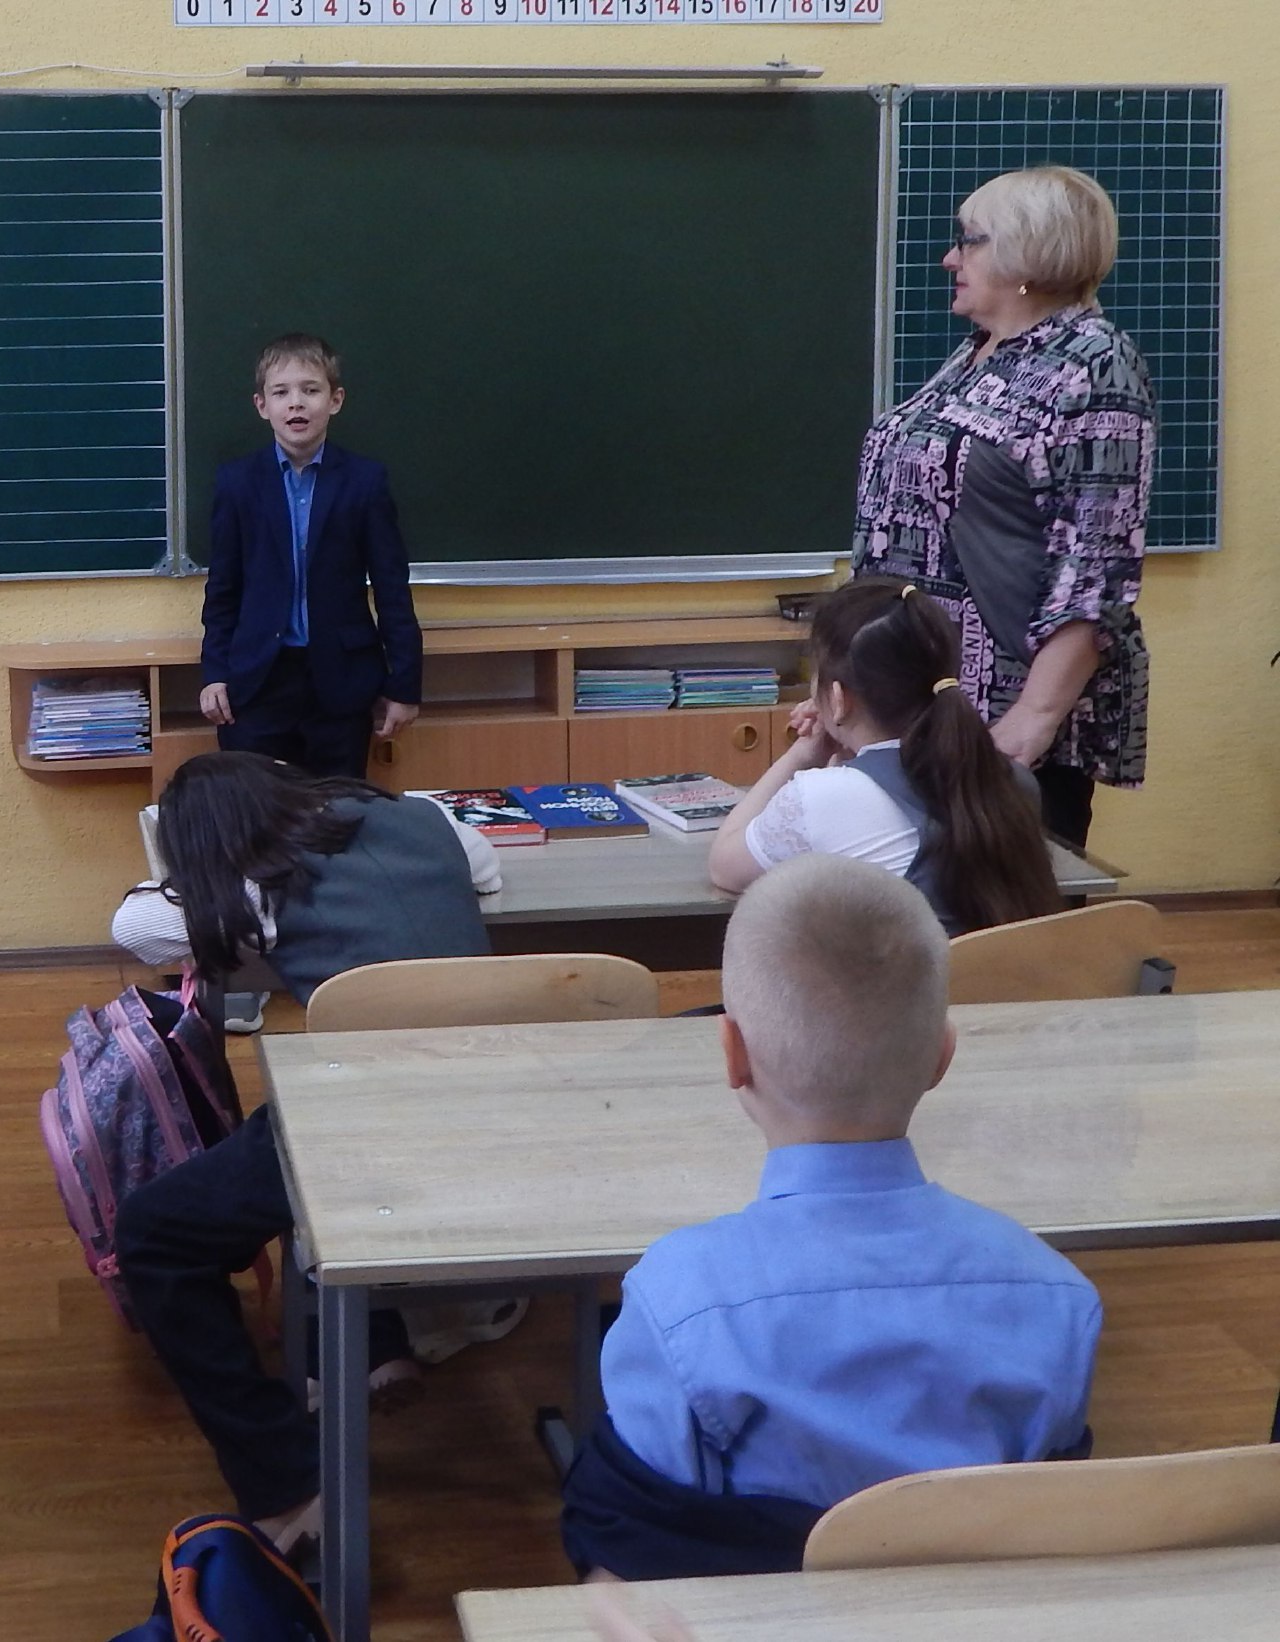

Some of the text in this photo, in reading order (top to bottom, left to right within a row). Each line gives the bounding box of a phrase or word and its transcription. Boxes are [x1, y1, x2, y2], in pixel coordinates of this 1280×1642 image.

[187, 0, 199, 16] 0
[223, 0, 232, 16] 1
[256, 0, 269, 16] 2
[291, 0, 303, 16] 3
[324, 0, 337, 16] 4
[359, 0, 371, 15] 5
[392, 0, 406, 15] 6
[461, 0, 472, 15] 8
[494, 0, 506, 15] 9
[521, 0, 546, 15] 10
[558, 0, 578, 15] 11
[591, 0, 613, 15] 12
[624, 0, 646, 15] 13
[658, 0, 680, 15] 14
[691, 0, 713, 14] 15
[721, 0, 747, 14] 16
[758, 0, 776, 13] 17
[790, 0, 812, 13] 18
[825, 0, 846, 13] 19
[854, 0, 878, 13] 20
